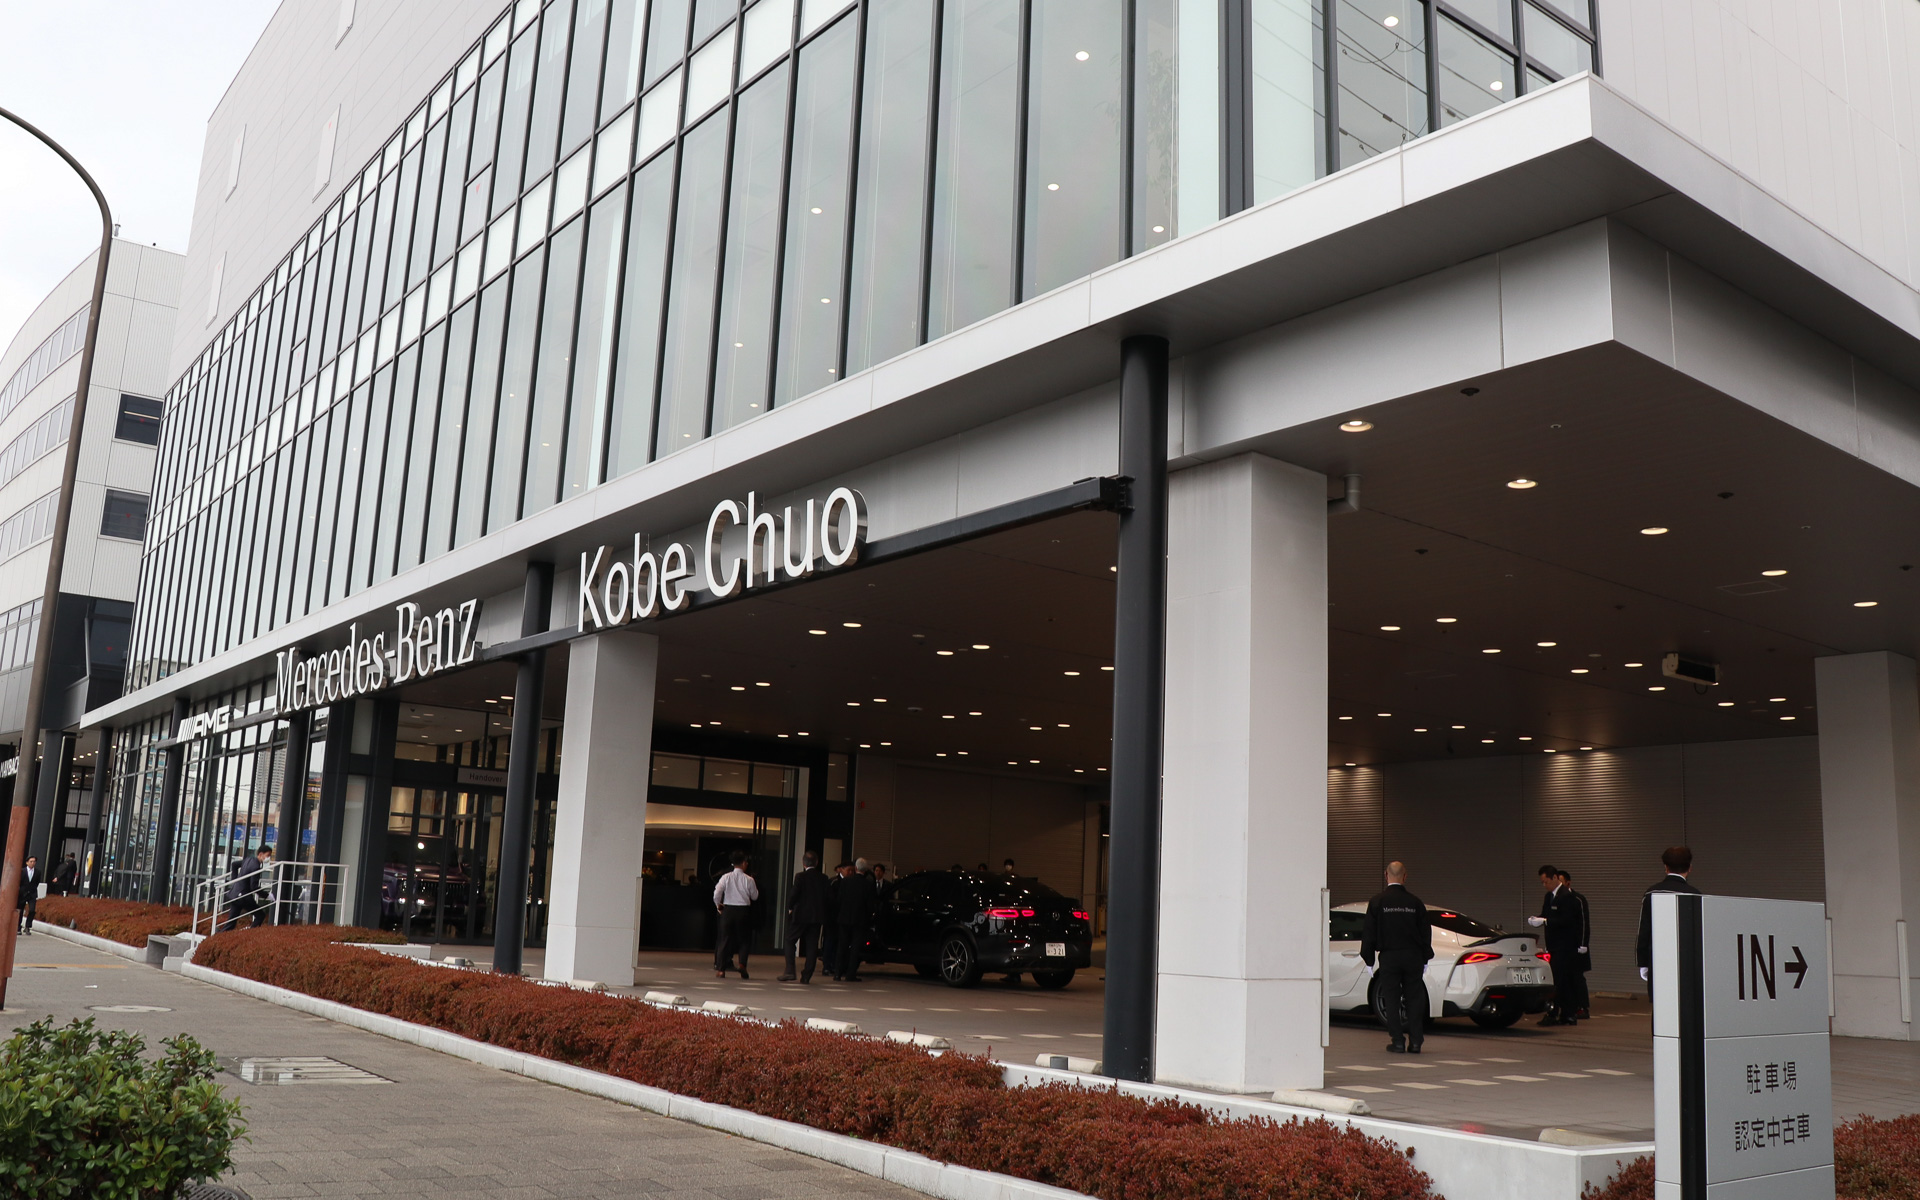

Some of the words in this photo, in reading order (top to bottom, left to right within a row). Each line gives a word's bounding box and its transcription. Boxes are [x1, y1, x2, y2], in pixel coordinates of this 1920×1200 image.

[272, 598, 477, 716] Mercedes-Benz
[577, 532, 688, 633] Kobe
[704, 487, 859, 598] Chuo
[191, 705, 230, 740] AMG
[469, 773, 503, 783] Handover
[1737, 934, 1776, 1000] IN
[1746, 1061, 1797, 1094] 駐車場
[1734, 1113, 1811, 1152] 認定中古車
